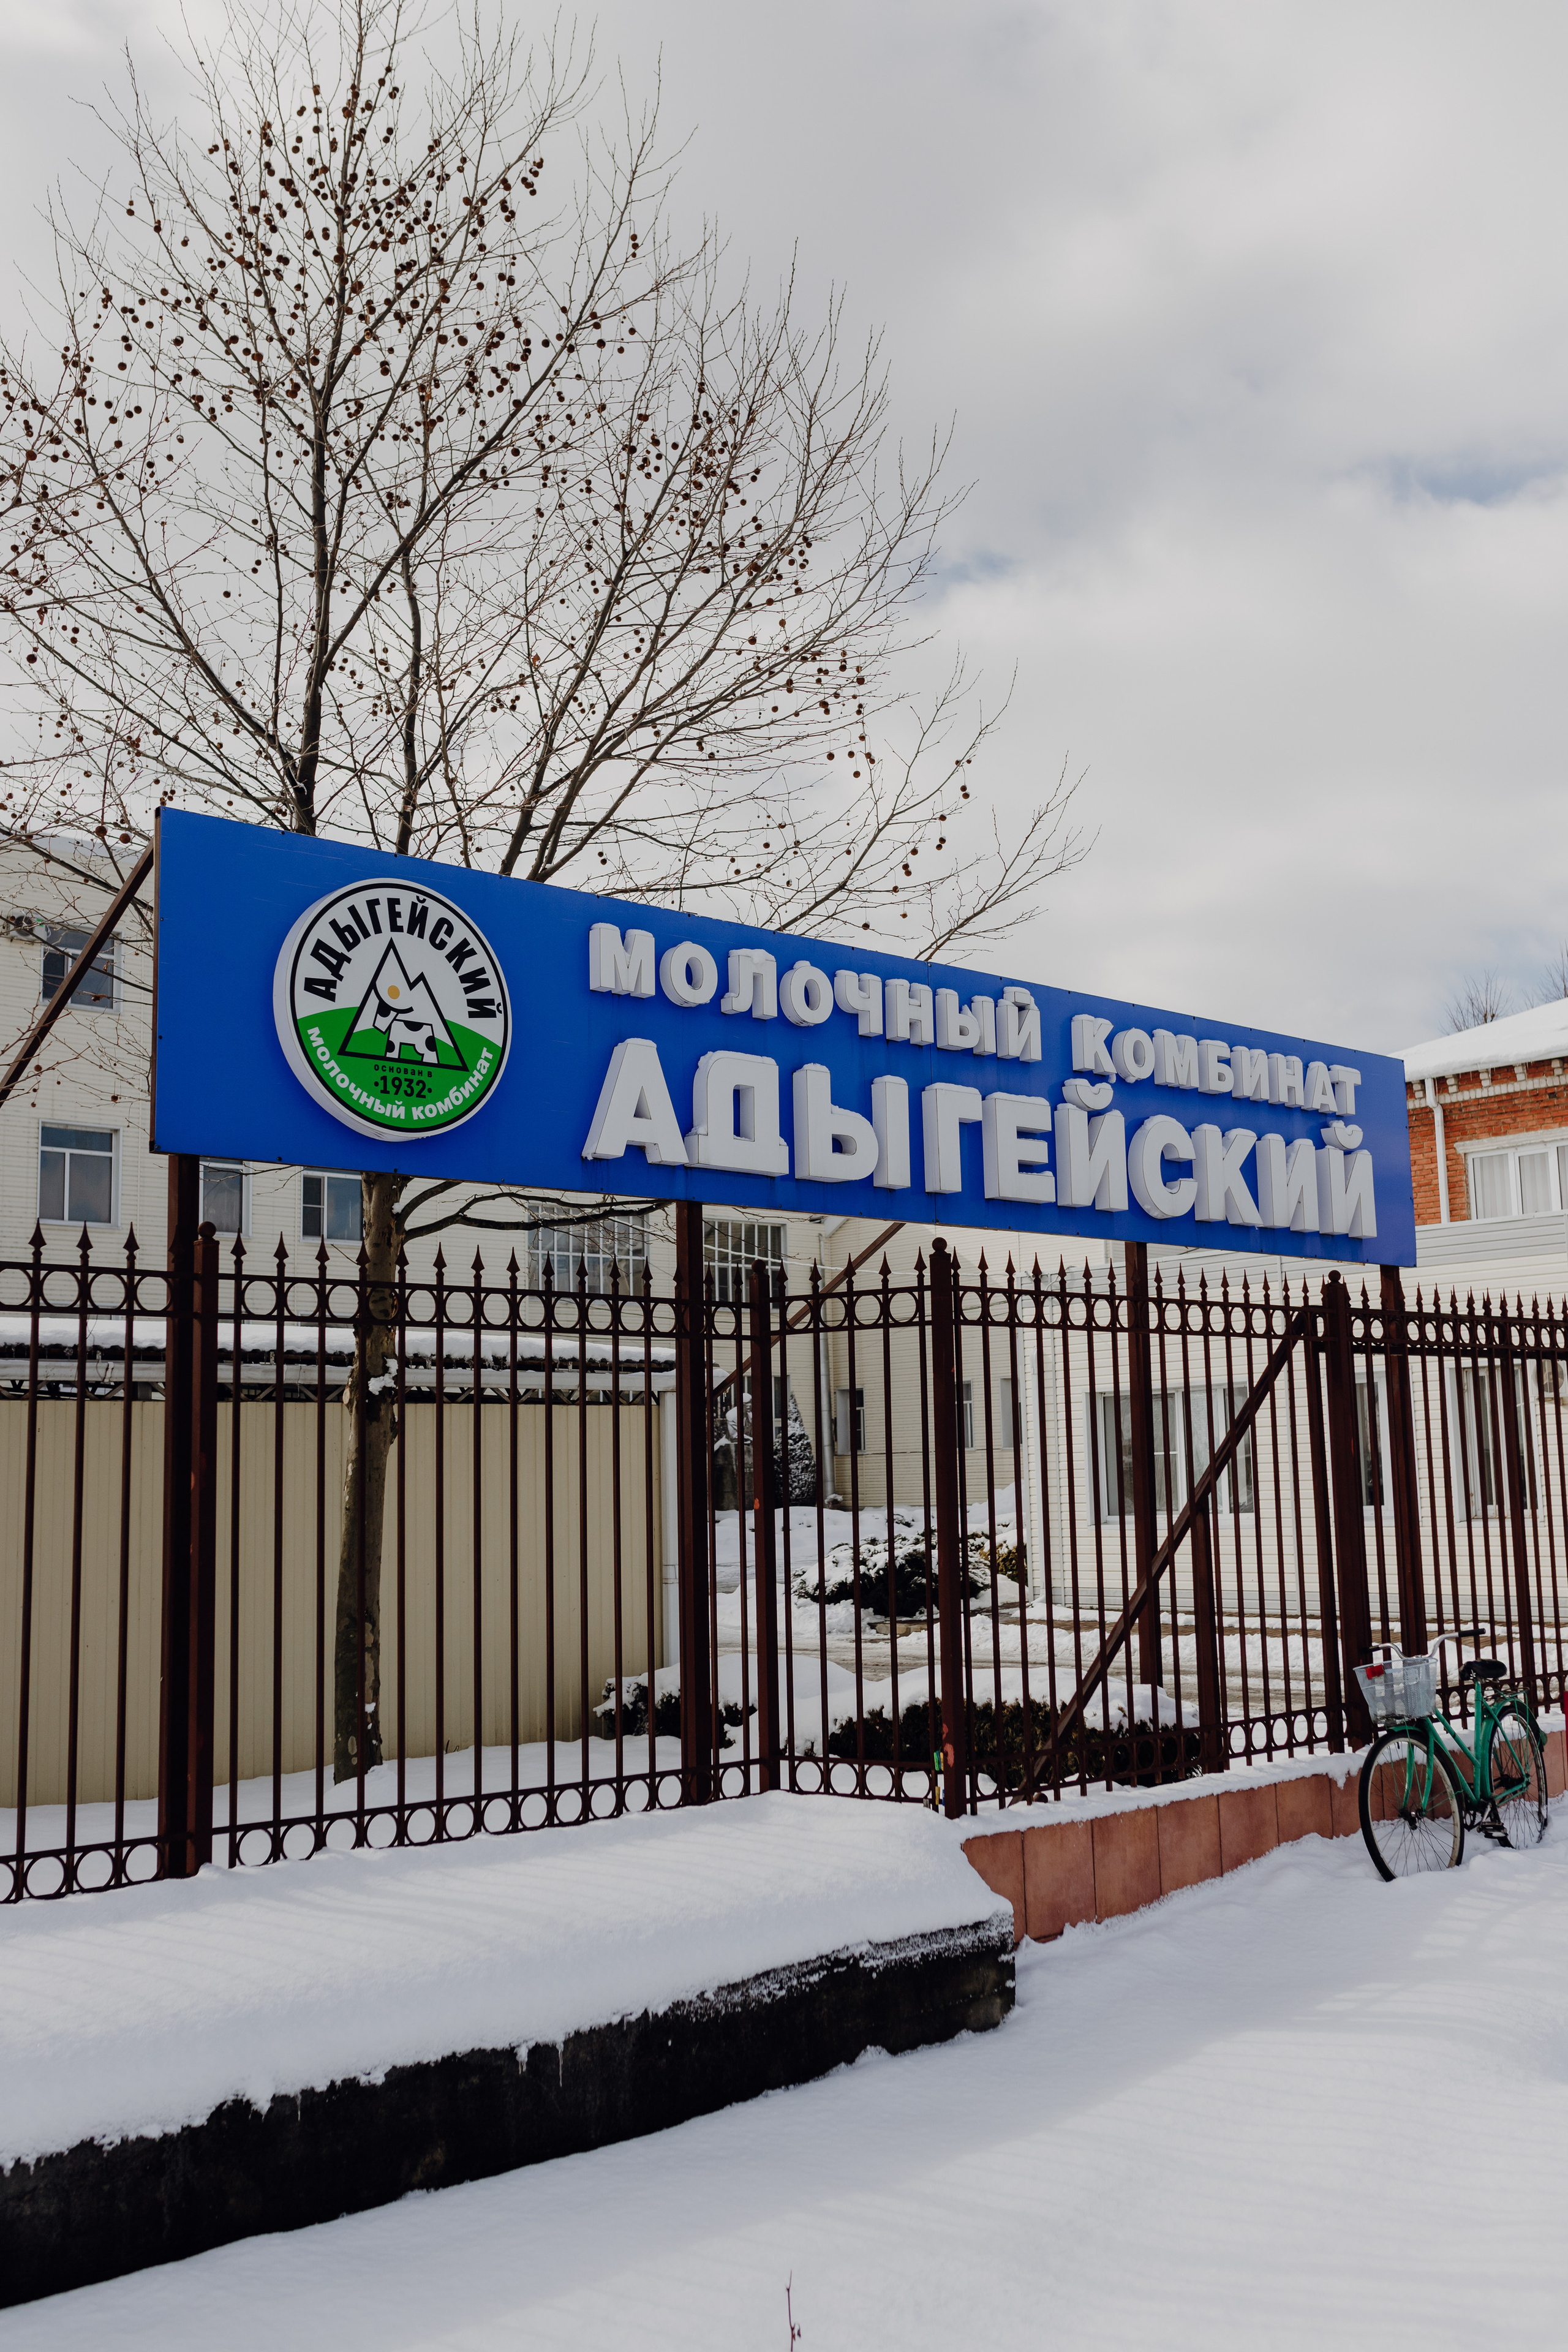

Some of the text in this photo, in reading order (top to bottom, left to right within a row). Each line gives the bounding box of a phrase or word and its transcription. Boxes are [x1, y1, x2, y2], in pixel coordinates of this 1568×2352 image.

[303, 895, 502, 1019] АДЫГЕЙСКИЙ
[589, 922, 1362, 1117] МОЛОЧНЫЙ КОМБИНАТ
[581, 1038, 1378, 1239] АДЫГЕЙСКИЙ
